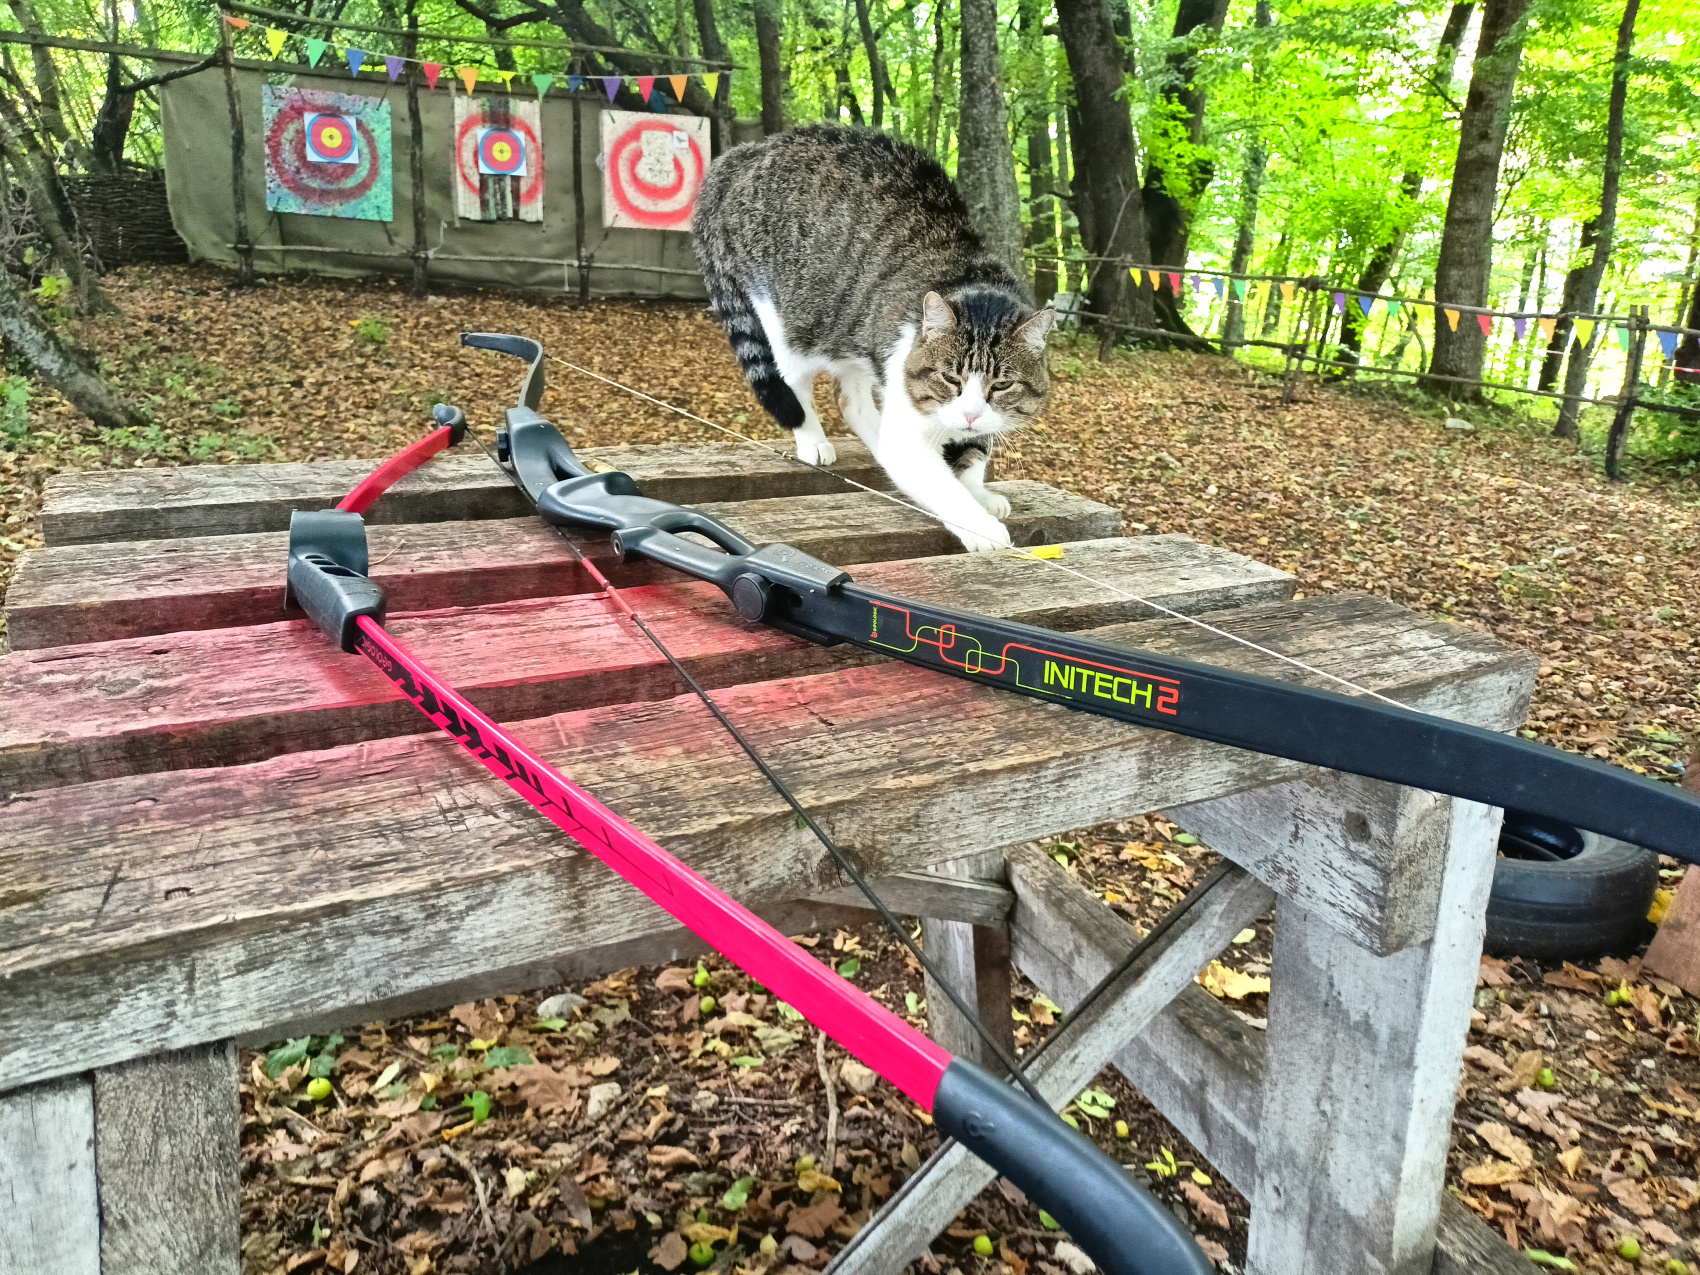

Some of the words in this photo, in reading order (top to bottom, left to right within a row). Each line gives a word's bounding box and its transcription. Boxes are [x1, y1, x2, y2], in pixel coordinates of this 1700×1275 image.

[361, 636, 393, 672] GEOLOGIC
[1043, 660, 1153, 708] INITECH
[1157, 685, 1180, 716] 2
